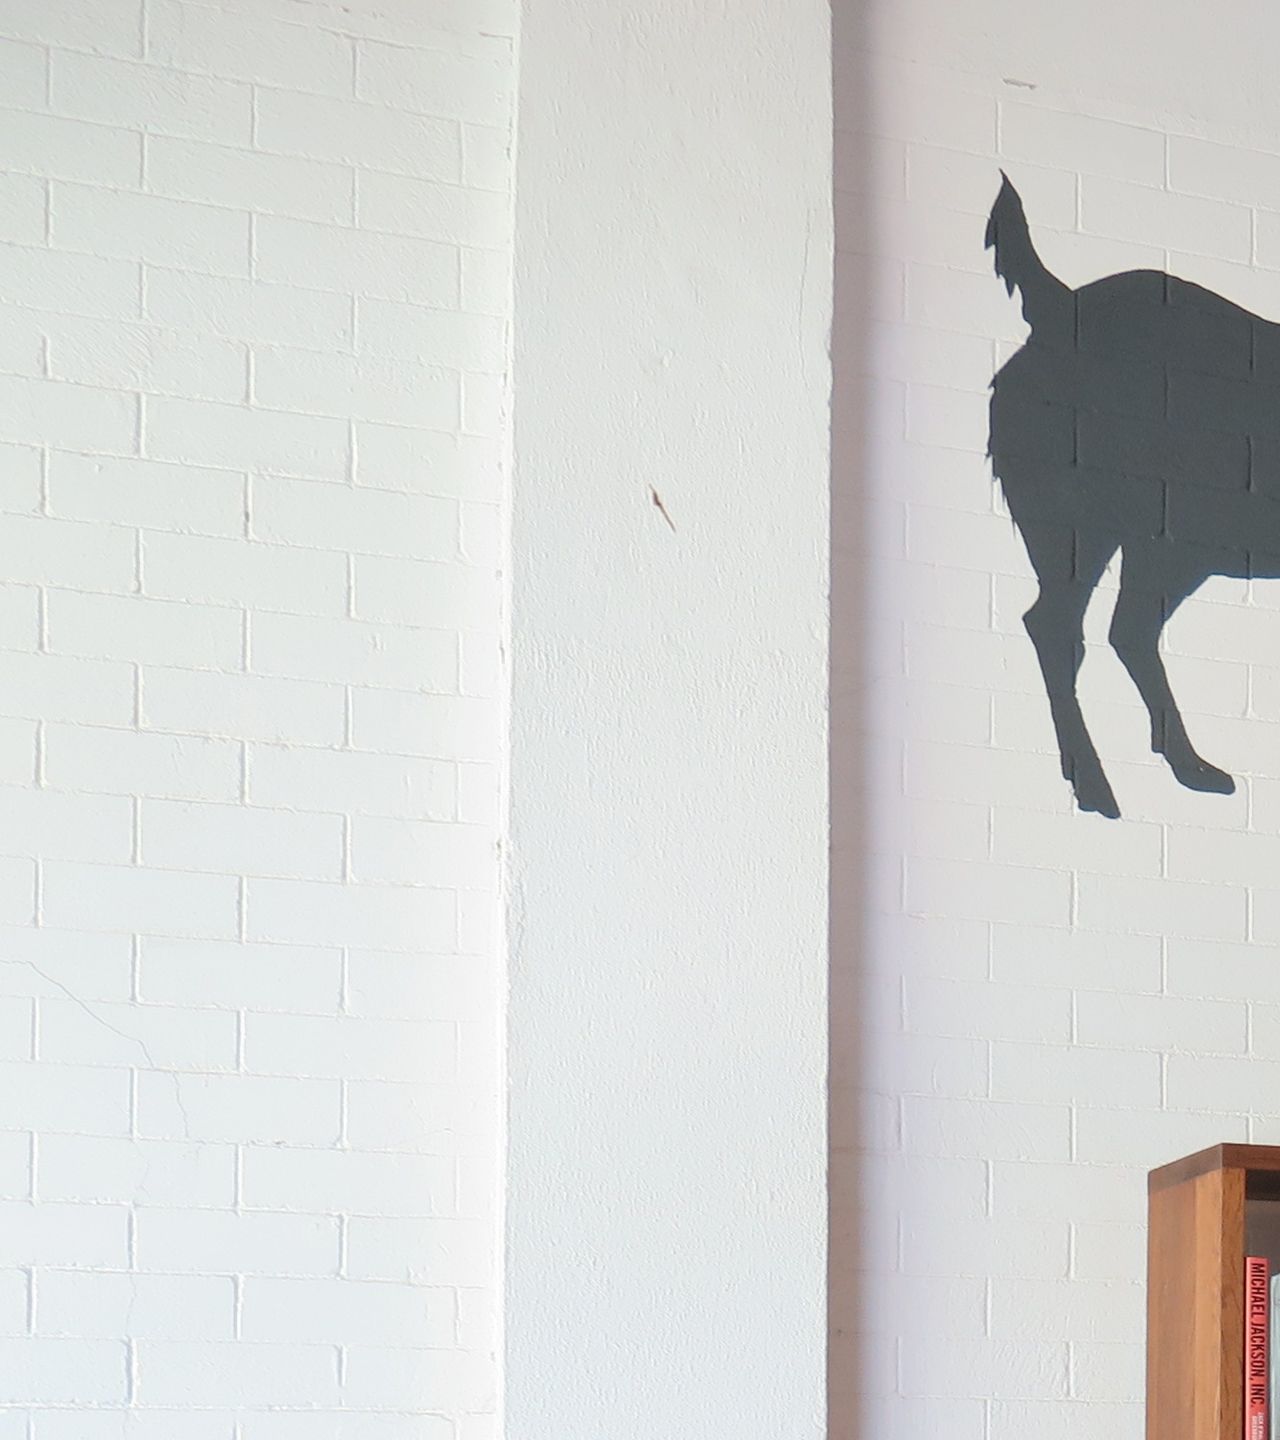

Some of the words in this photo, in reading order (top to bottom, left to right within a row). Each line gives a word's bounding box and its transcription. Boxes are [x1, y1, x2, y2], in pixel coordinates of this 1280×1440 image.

[1251, 1263, 1265, 1317] MICHAEL
[1250, 1321, 1265, 1381] JACKSON,
[1251, 1384, 1265, 1408] INC.
